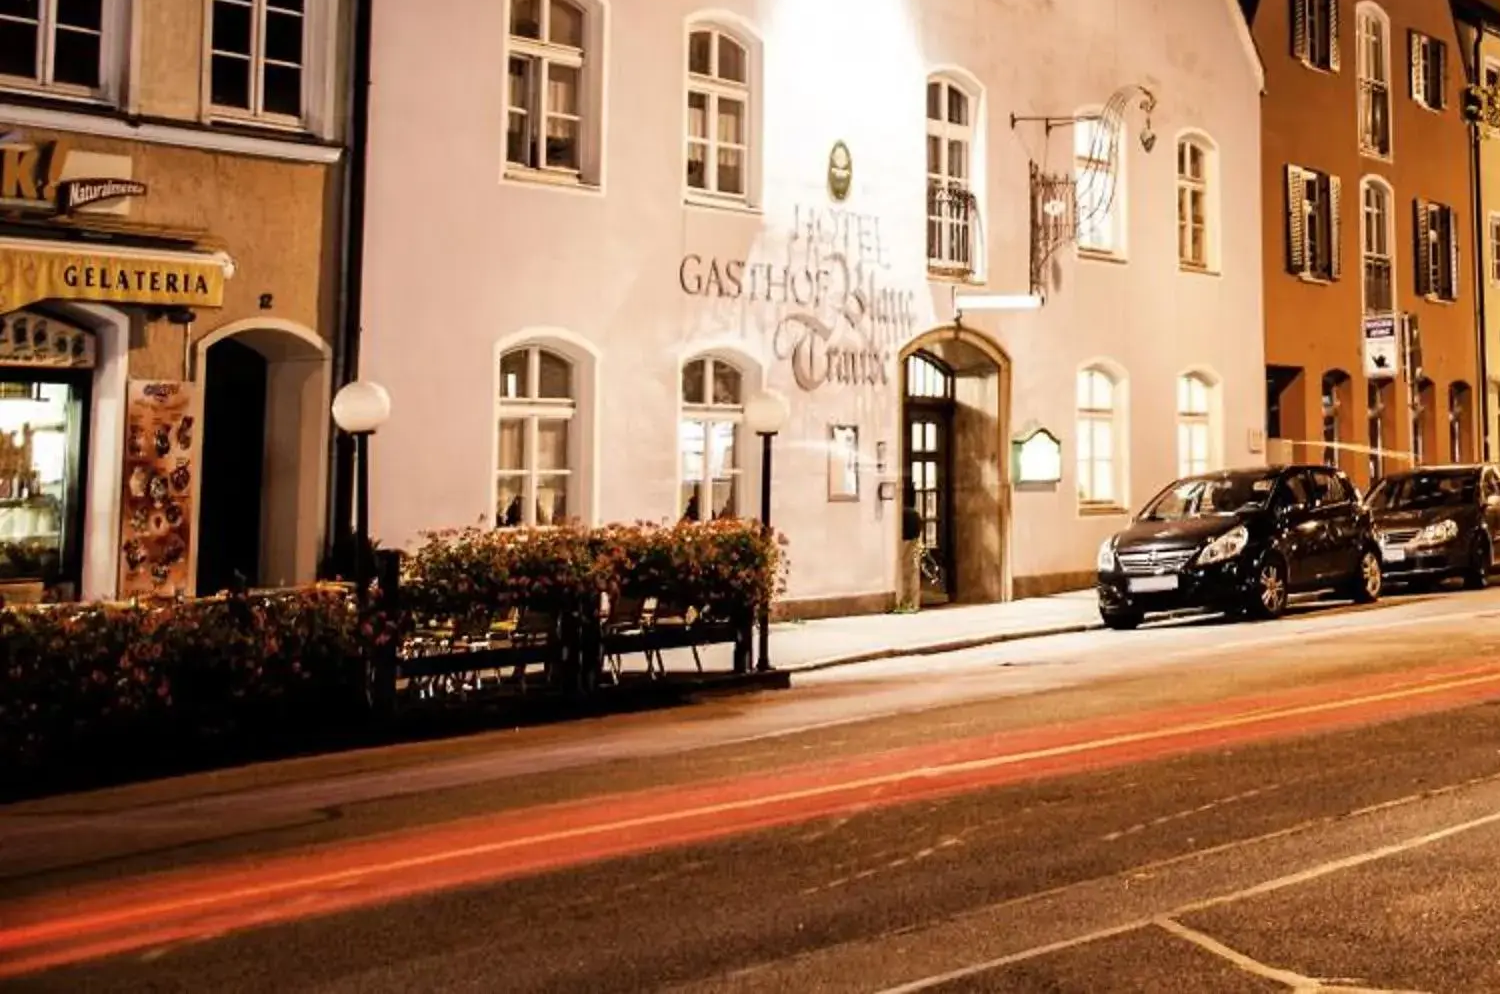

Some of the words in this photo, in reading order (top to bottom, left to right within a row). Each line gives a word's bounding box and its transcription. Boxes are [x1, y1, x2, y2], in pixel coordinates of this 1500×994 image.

[791, 203, 891, 253] HOTEL
[63, 265, 209, 294] GELATERIA
[679, 254, 829, 307] GASTHOF
